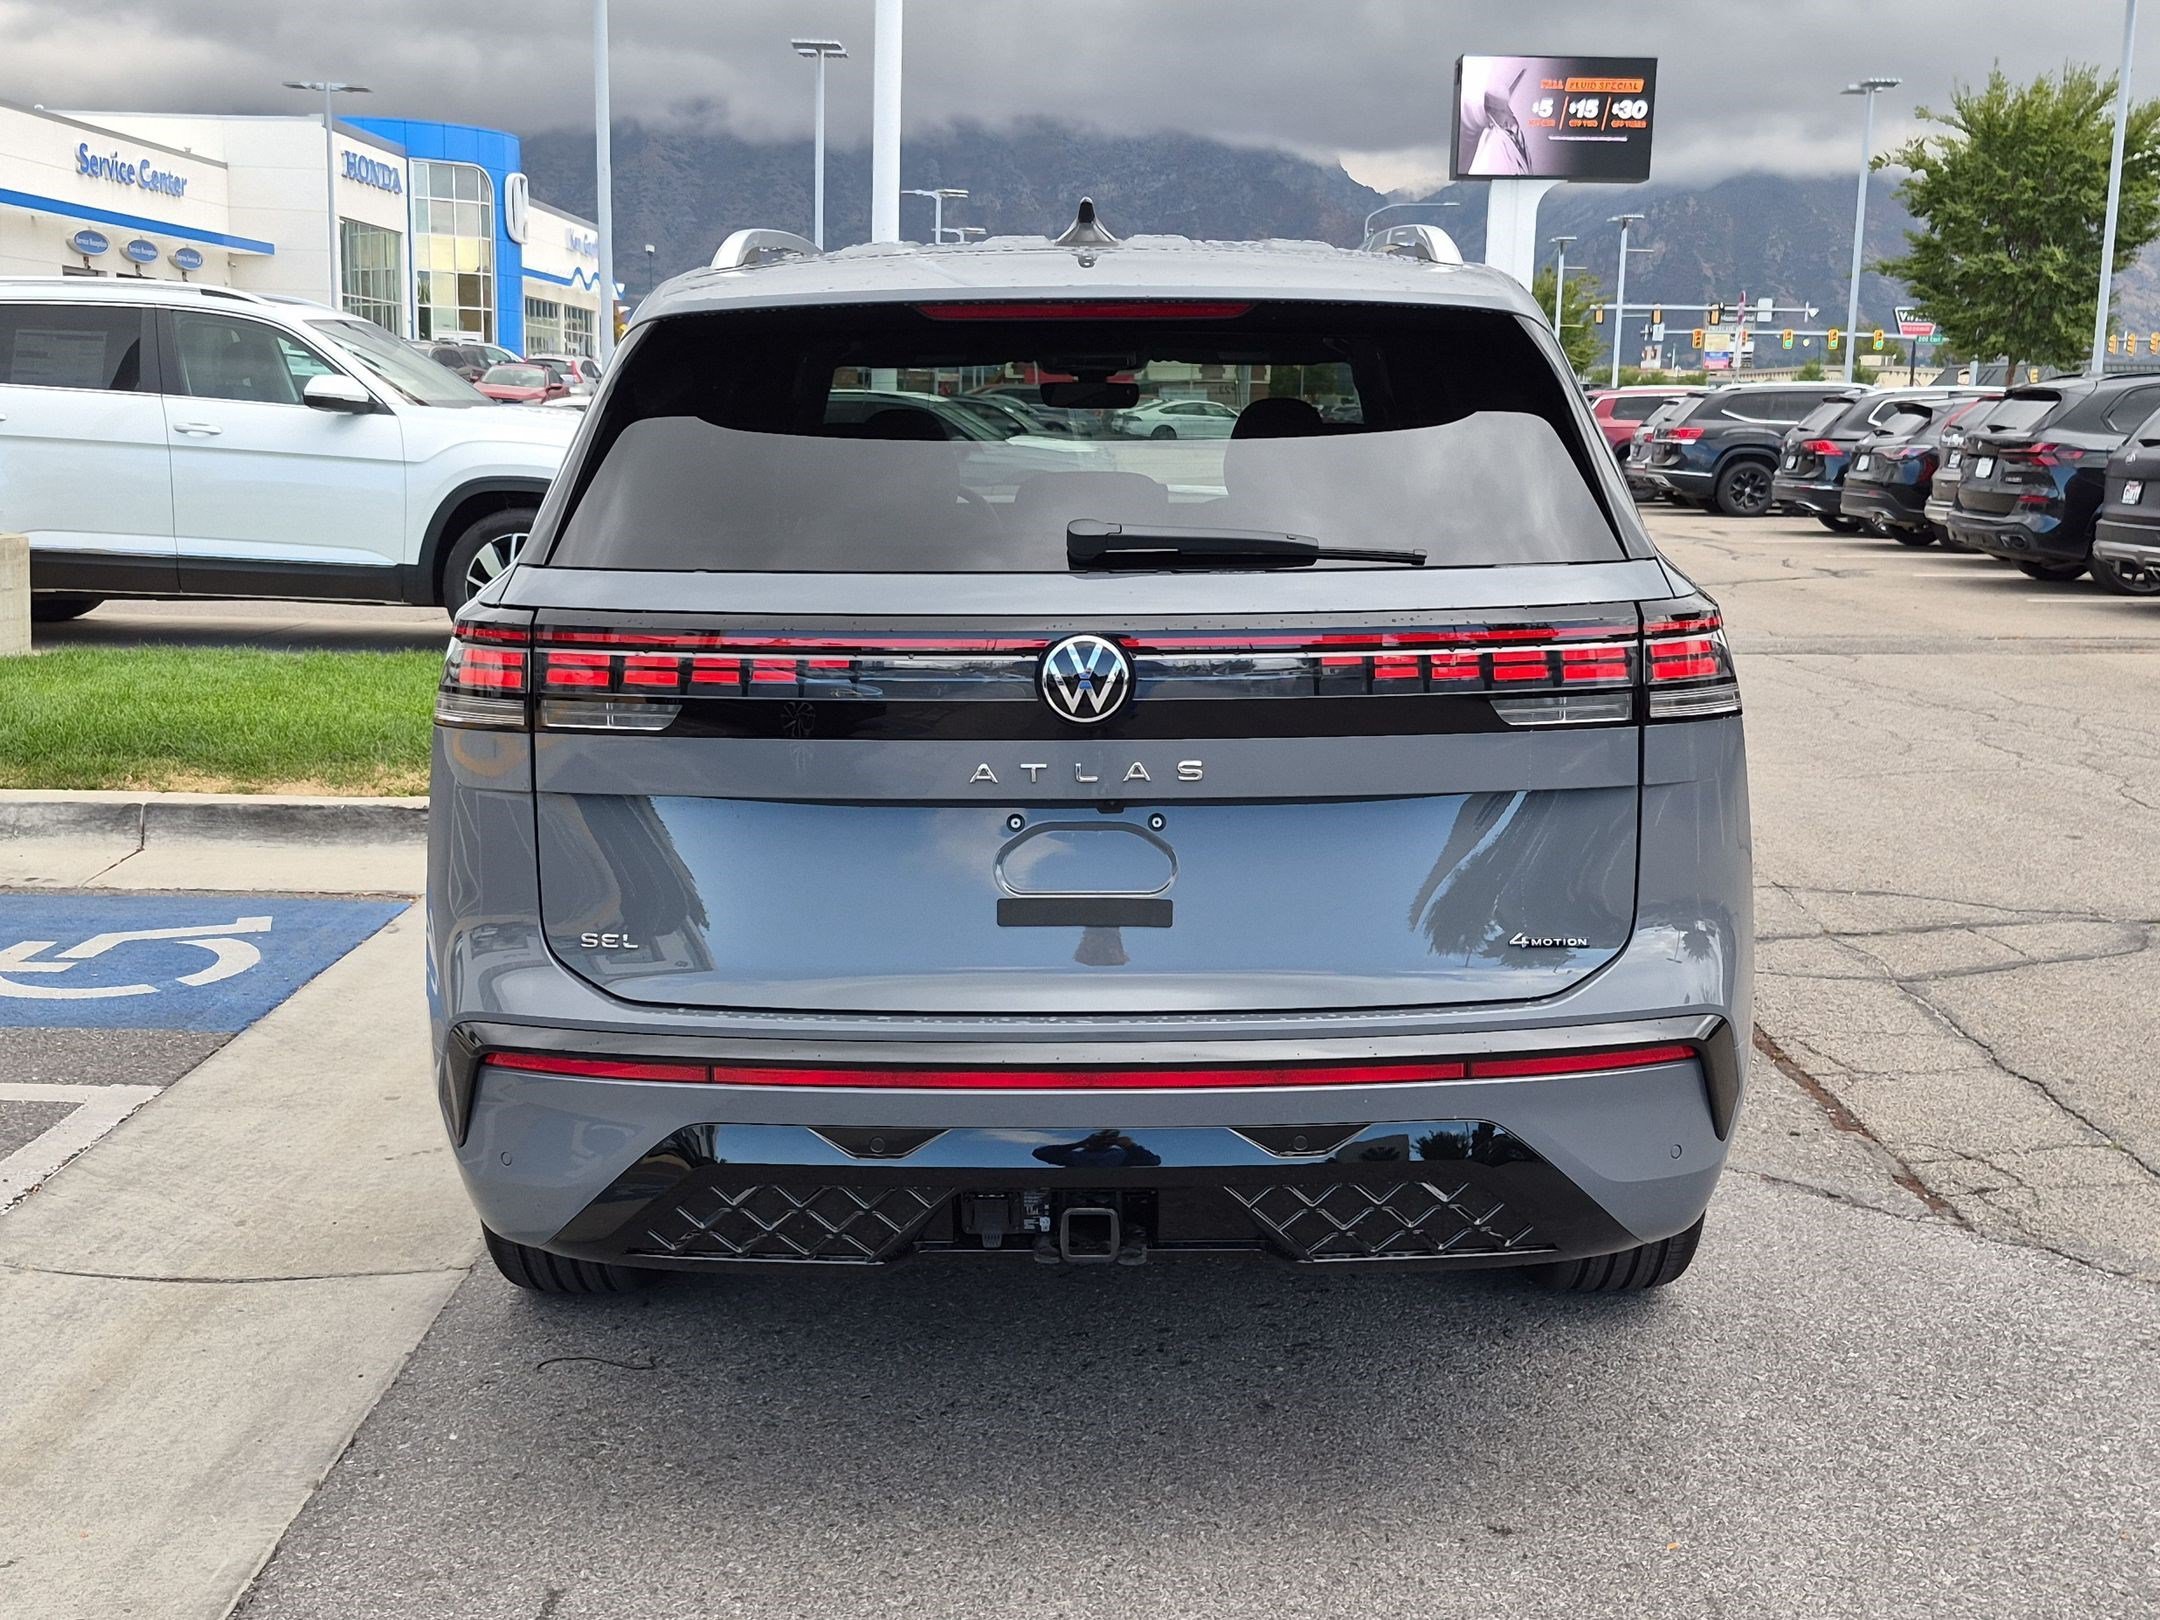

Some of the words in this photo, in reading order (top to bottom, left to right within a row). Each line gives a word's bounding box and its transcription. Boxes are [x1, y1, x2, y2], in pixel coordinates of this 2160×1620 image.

[1569, 81, 1596, 90] FLUID
[1599, 81, 1639, 91] SPECIAL
[75, 142, 136, 186] Service
[136, 159, 187, 198] Center
[341, 150, 403, 195] HONDA
[970, 760, 1203, 784] ATLAS
[580, 932, 639, 948] SEL
[1508, 932, 1588, 949] 4MOTION
